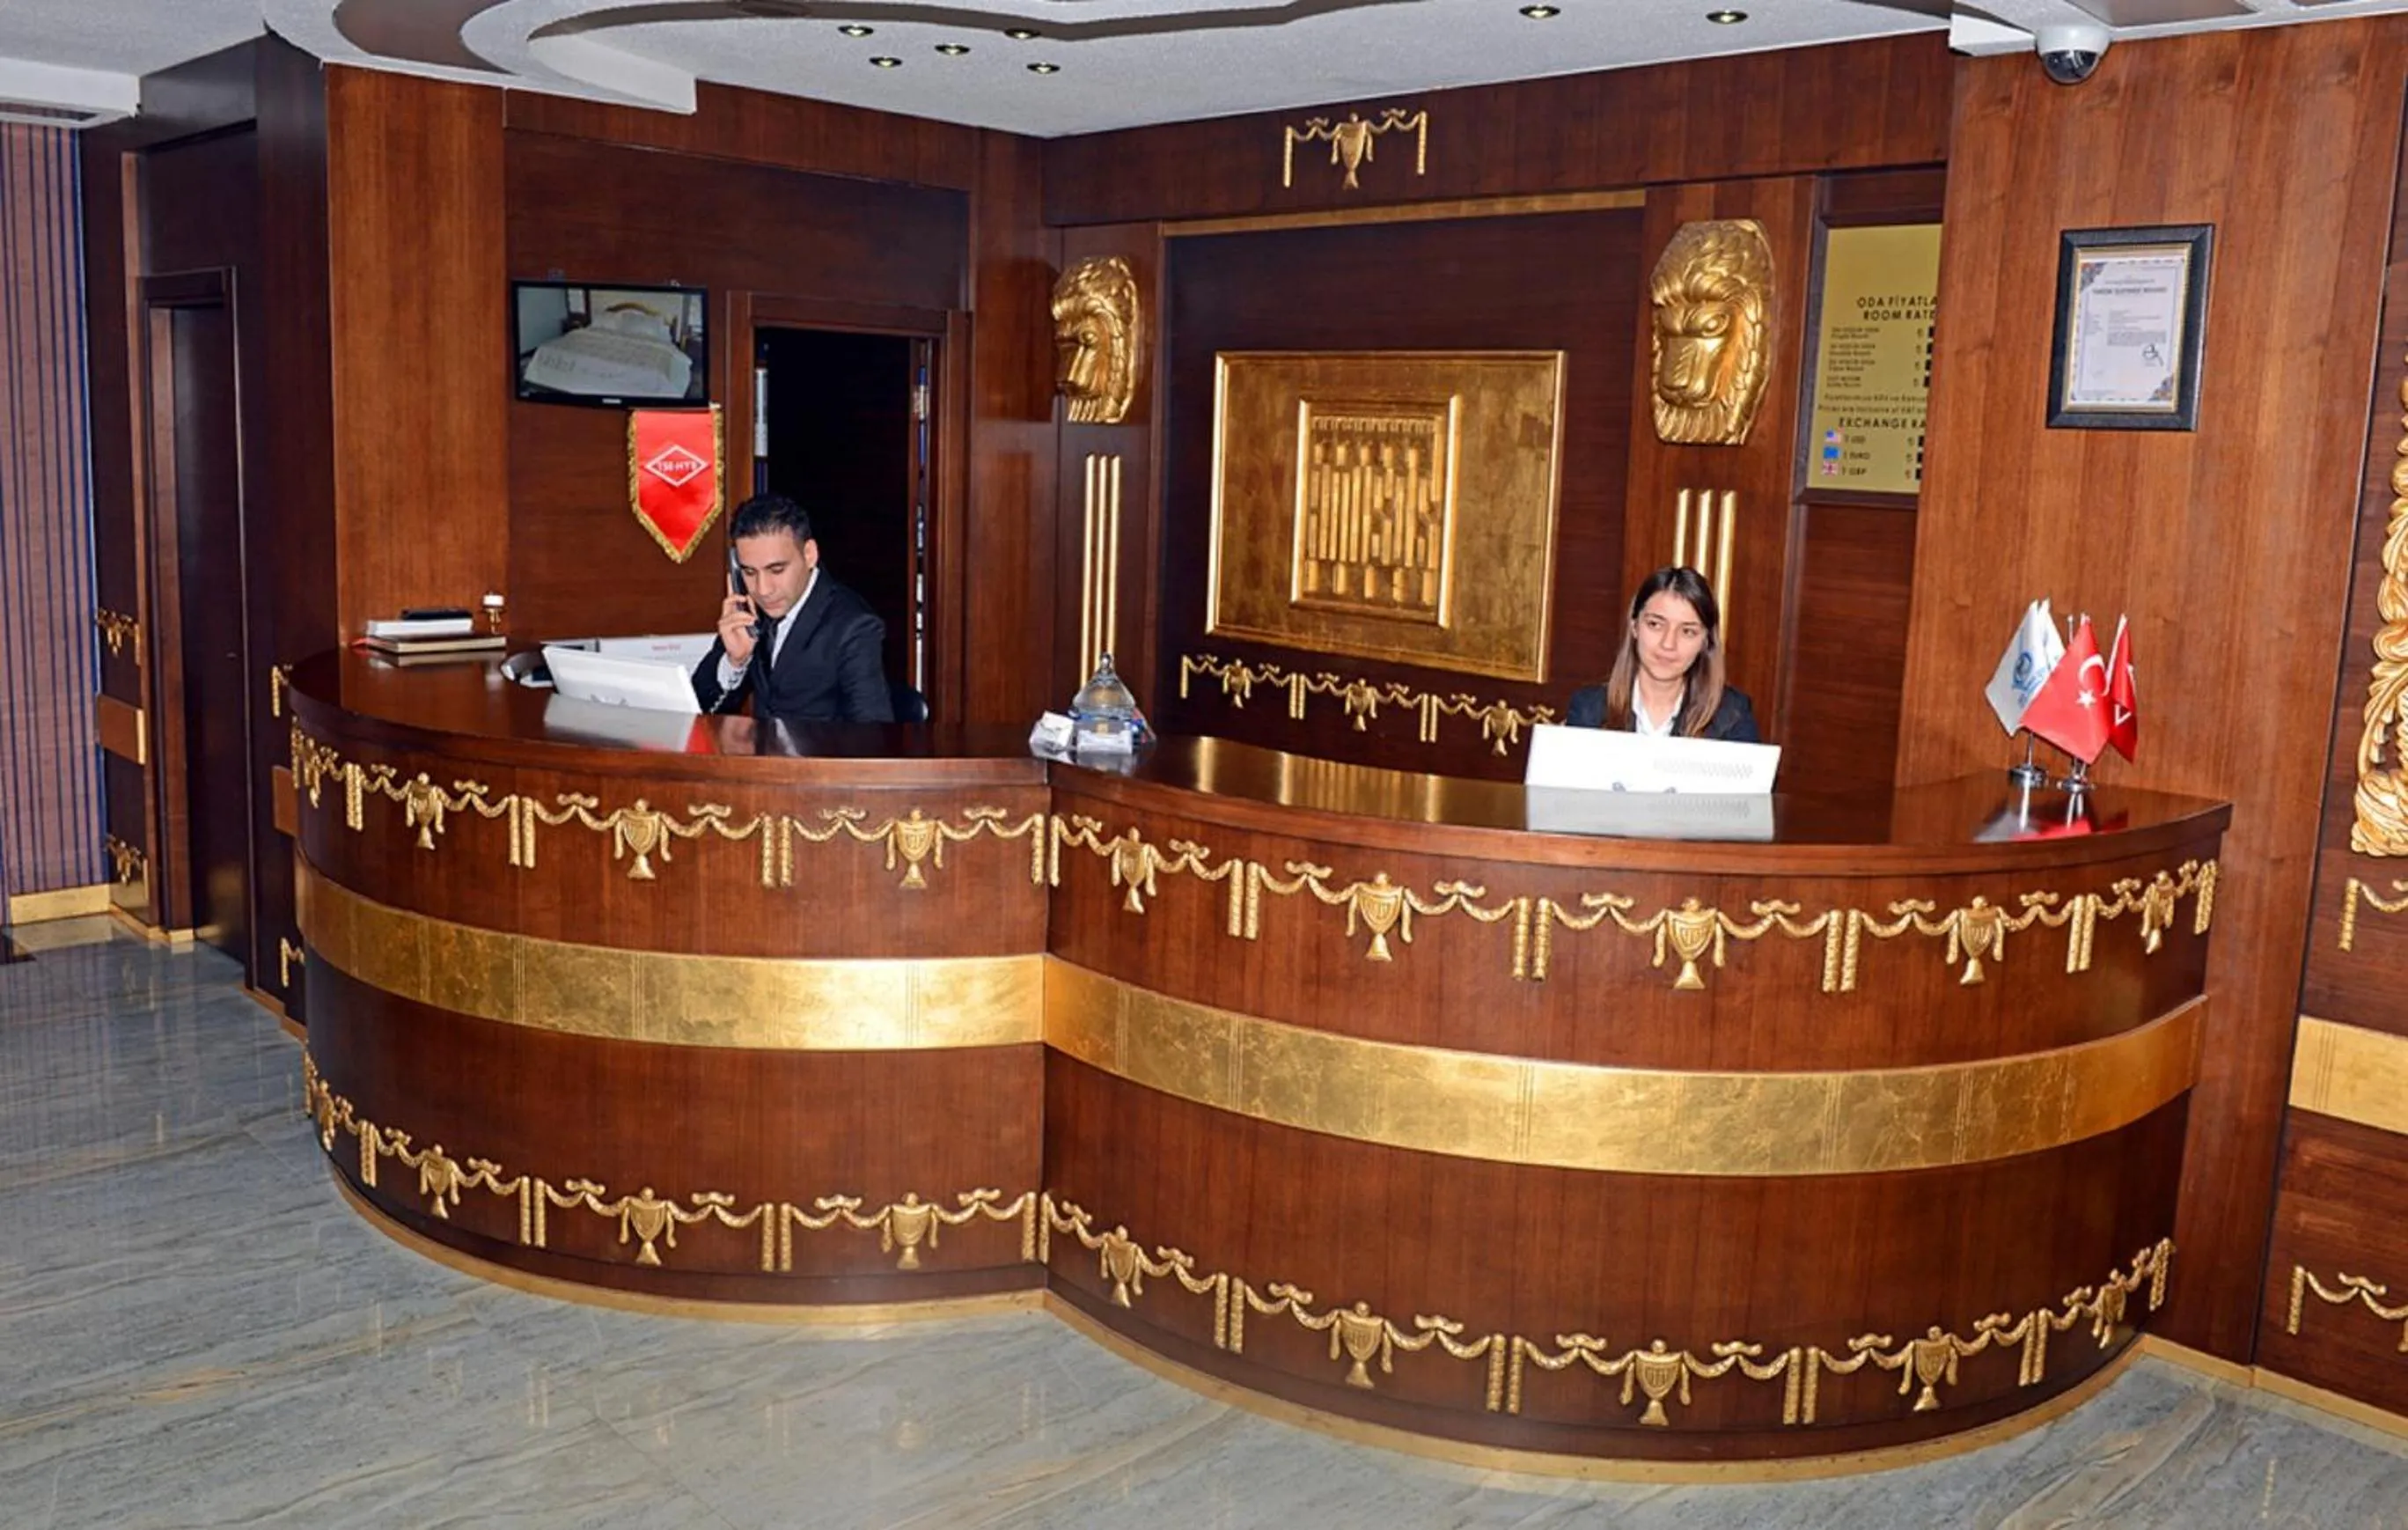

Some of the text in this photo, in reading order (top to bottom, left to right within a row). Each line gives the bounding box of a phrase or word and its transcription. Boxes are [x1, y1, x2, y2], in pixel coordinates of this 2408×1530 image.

[1856, 296, 1884, 308] ODA
[1863, 309, 1901, 321] ROOM
[1839, 416, 1907, 429] EXCHANGE
